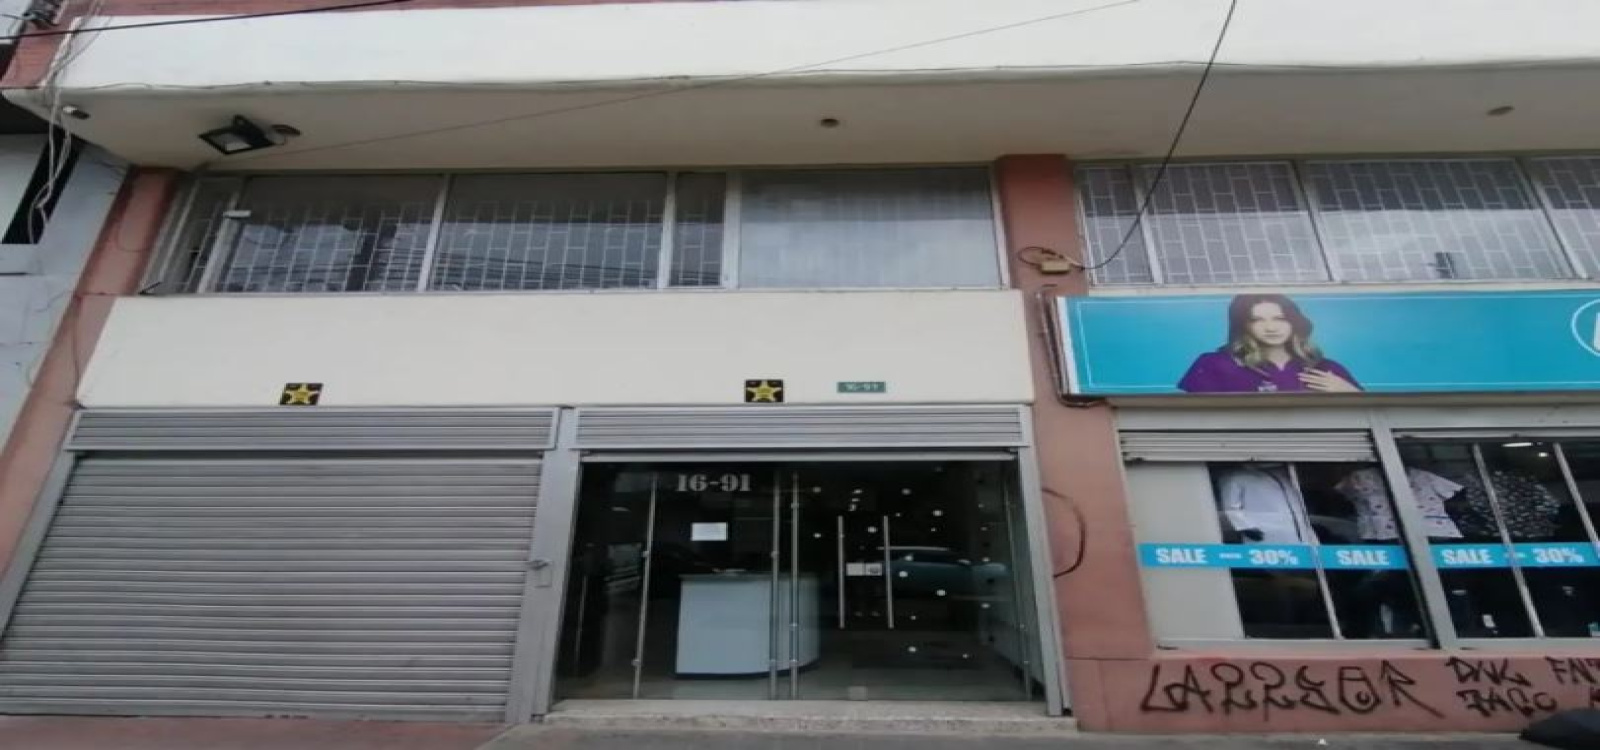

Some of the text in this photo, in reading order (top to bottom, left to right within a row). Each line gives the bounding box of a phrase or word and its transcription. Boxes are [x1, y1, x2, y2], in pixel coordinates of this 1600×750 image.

[676, 473, 752, 492] 16-91
[1156, 548, 1207, 564] SALE
[1248, 549, 1299, 566] 30%
[1336, 549, 1389, 566] SALE
[1441, 548, 1493, 564] SALE
[1532, 547, 1585, 563] 30%
